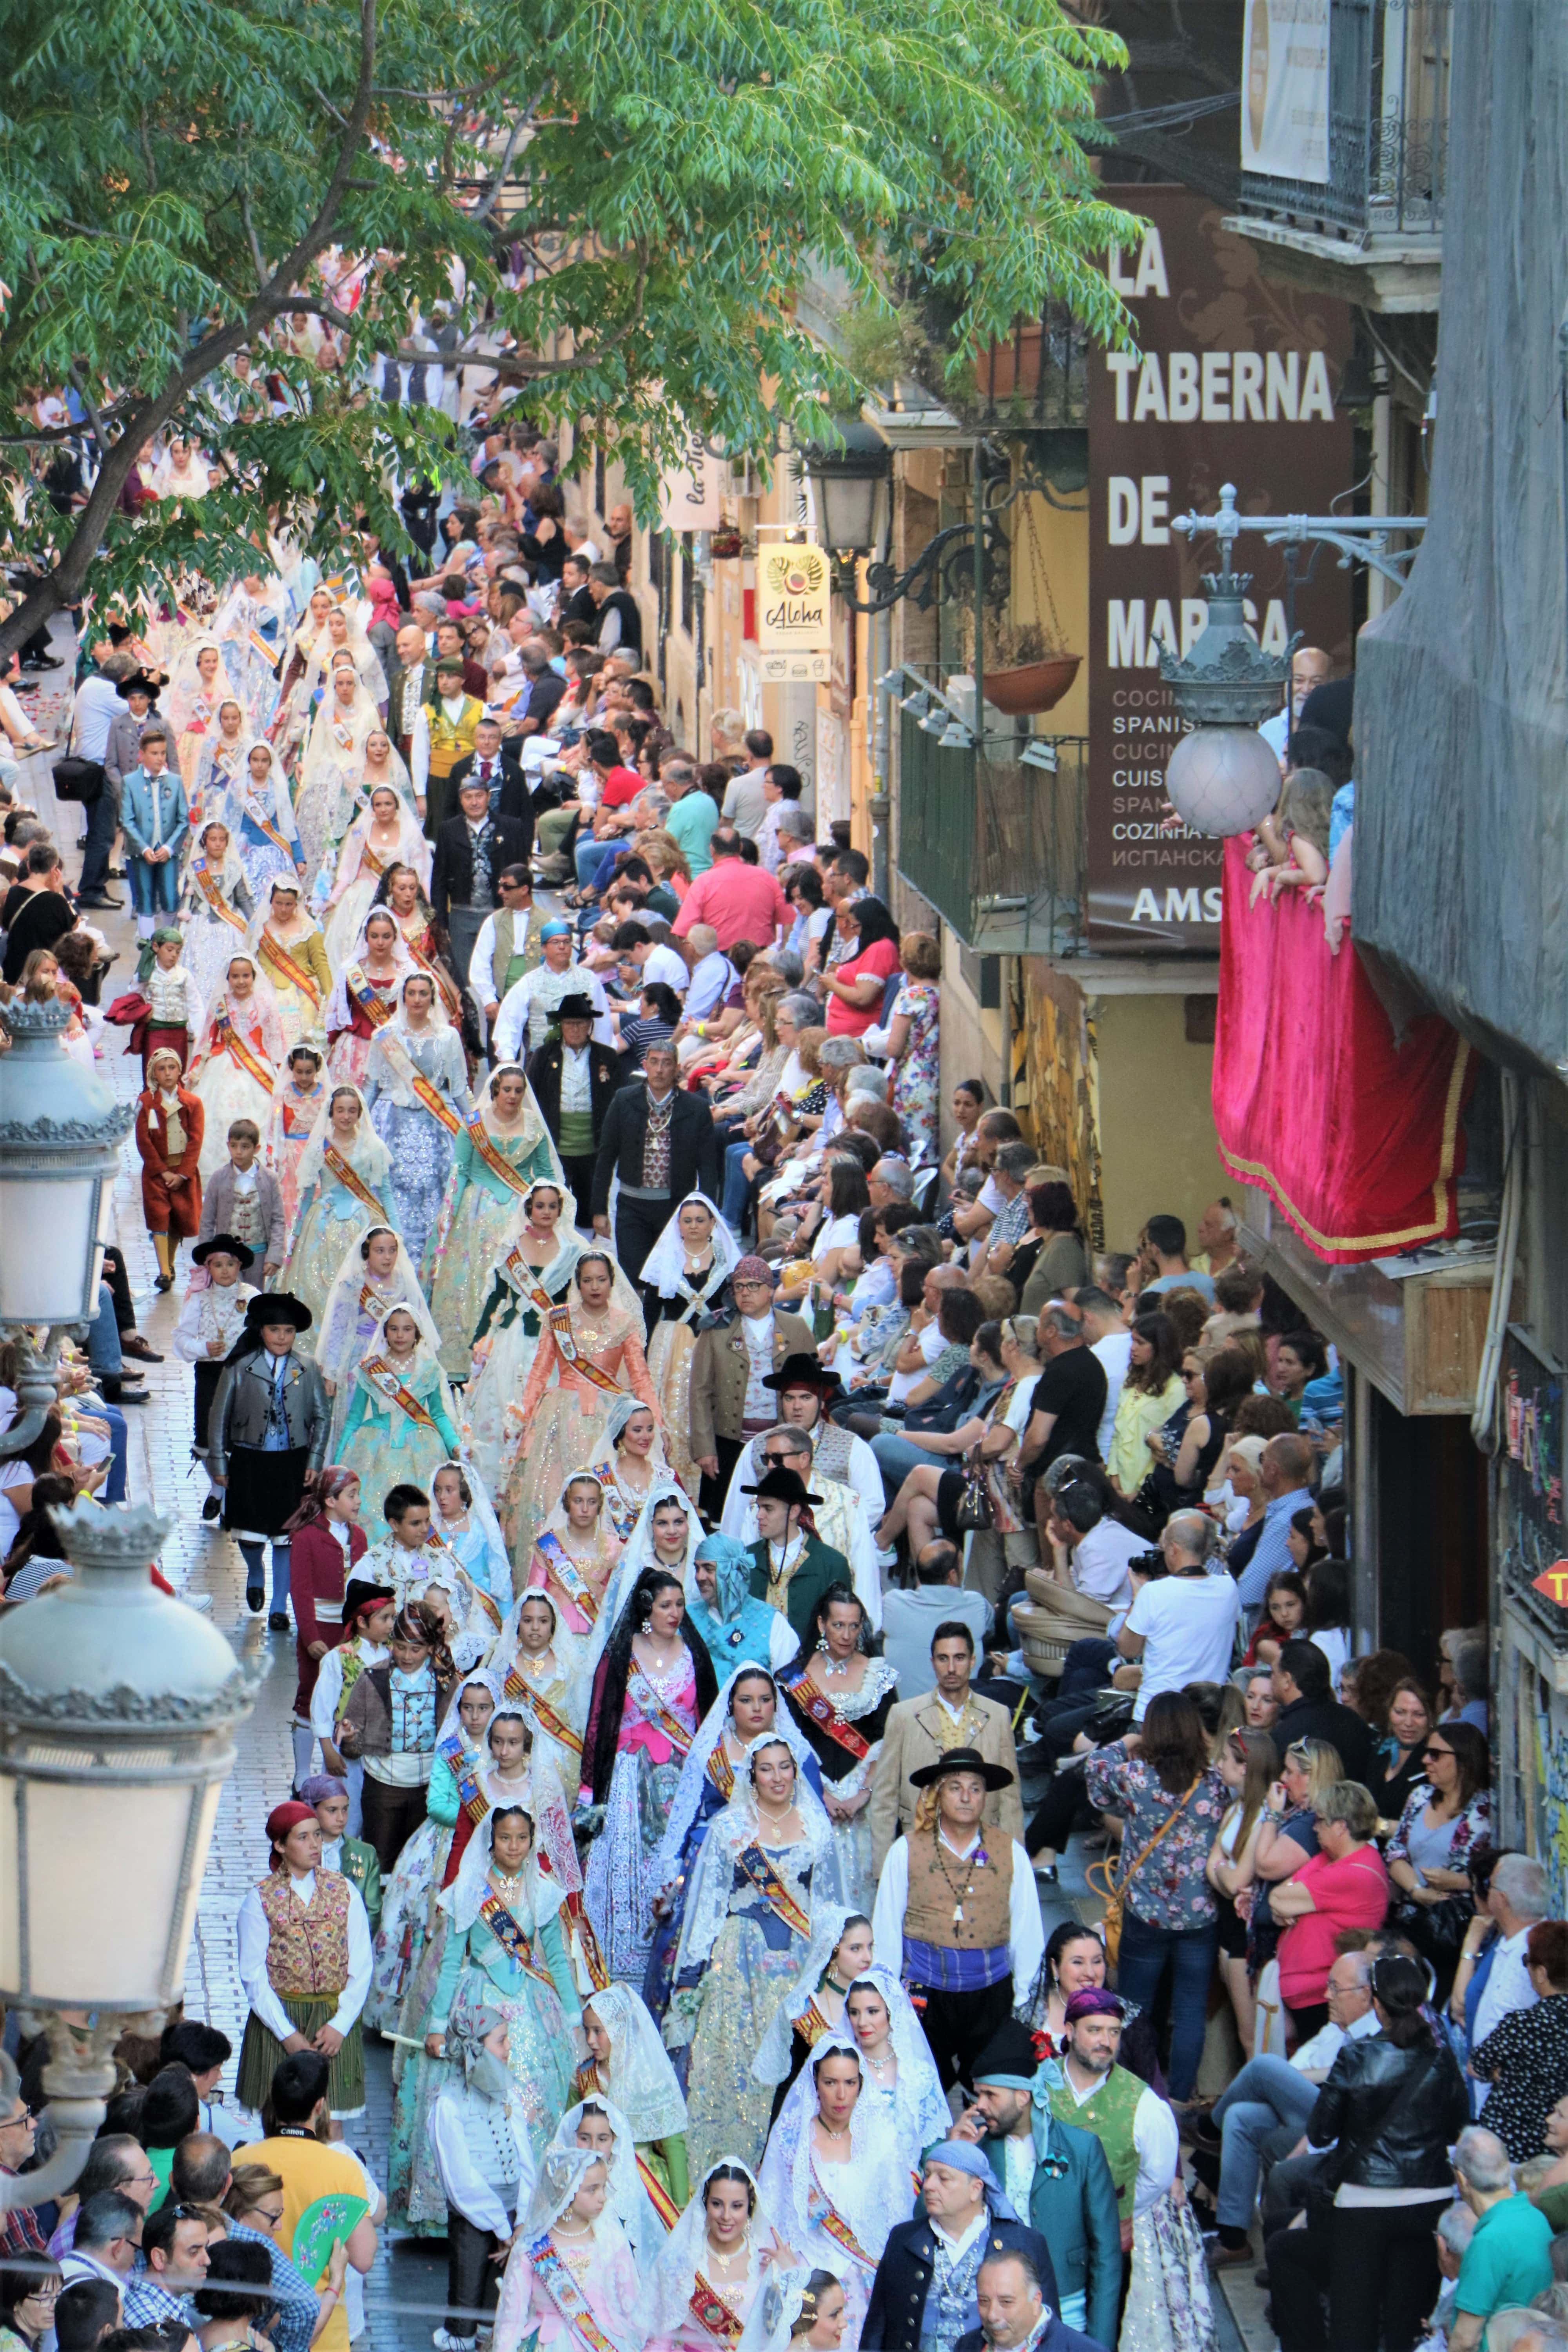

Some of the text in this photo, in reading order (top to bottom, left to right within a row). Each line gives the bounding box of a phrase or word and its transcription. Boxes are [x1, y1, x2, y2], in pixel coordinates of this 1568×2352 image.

[1108, 227, 1171, 298] LA
[1106, 352, 1335, 422] TABERNA
[1108, 475, 1170, 545] DE
[766, 601, 823, 630] Aloha
[1112, 716, 1201, 733] SPANIS
[1112, 824, 1202, 840] COZINHA
[1130, 887, 1223, 922] AMS
[1548, 1573, 1568, 1601] T
[280, 2128, 304, 2136] Canon
